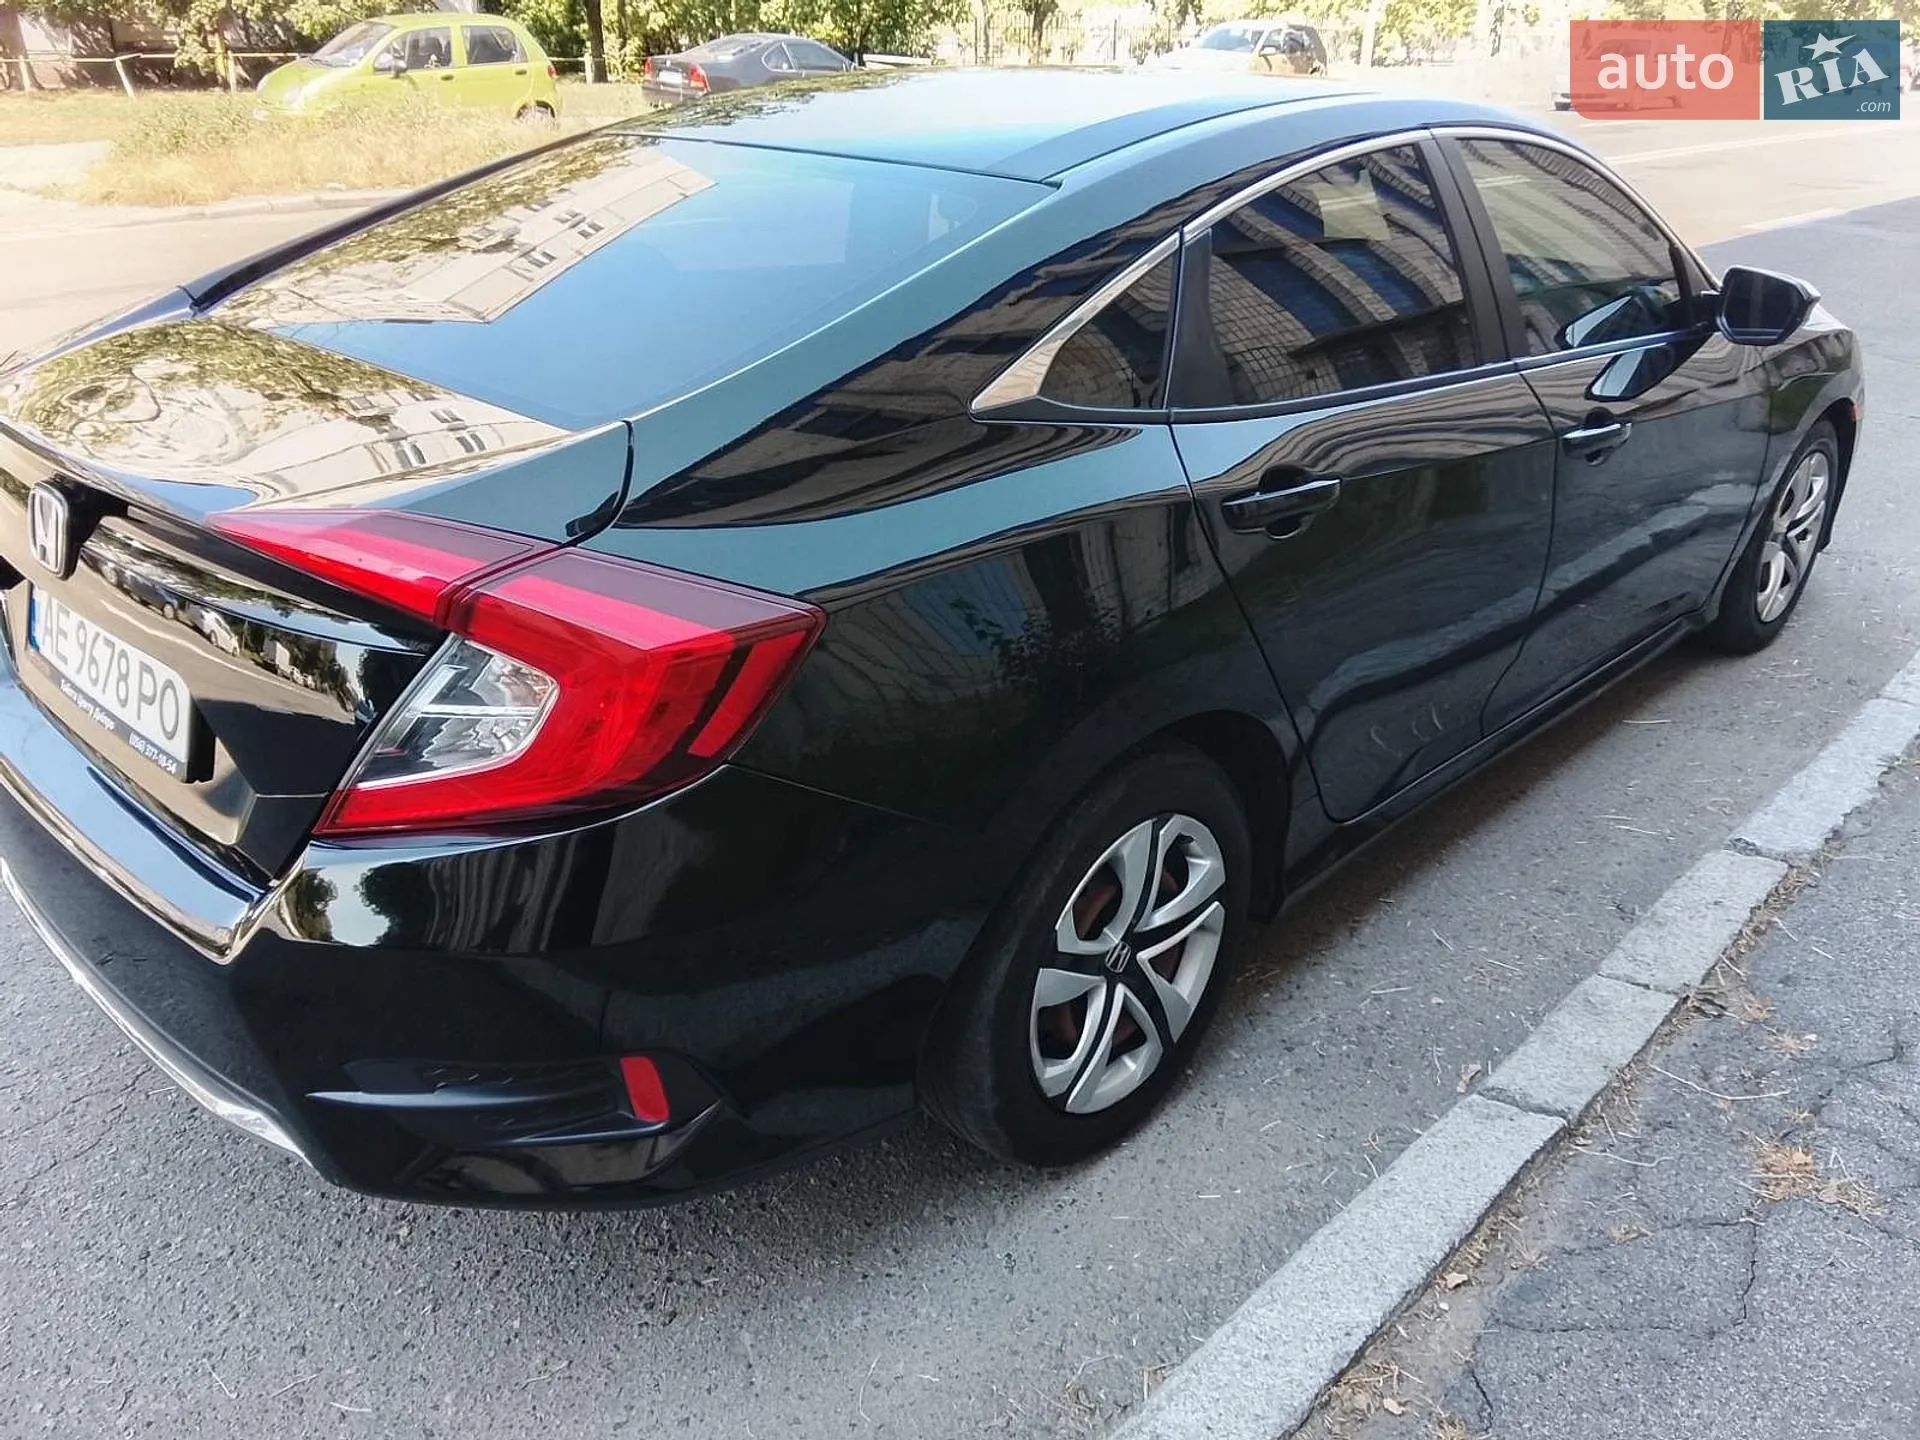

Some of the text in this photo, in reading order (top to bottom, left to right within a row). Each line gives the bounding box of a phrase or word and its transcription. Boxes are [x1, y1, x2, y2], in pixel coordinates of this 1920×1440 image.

[42, 598, 70, 666] AE
[76, 620, 130, 708] 9678
[136, 660, 179, 741] PO
